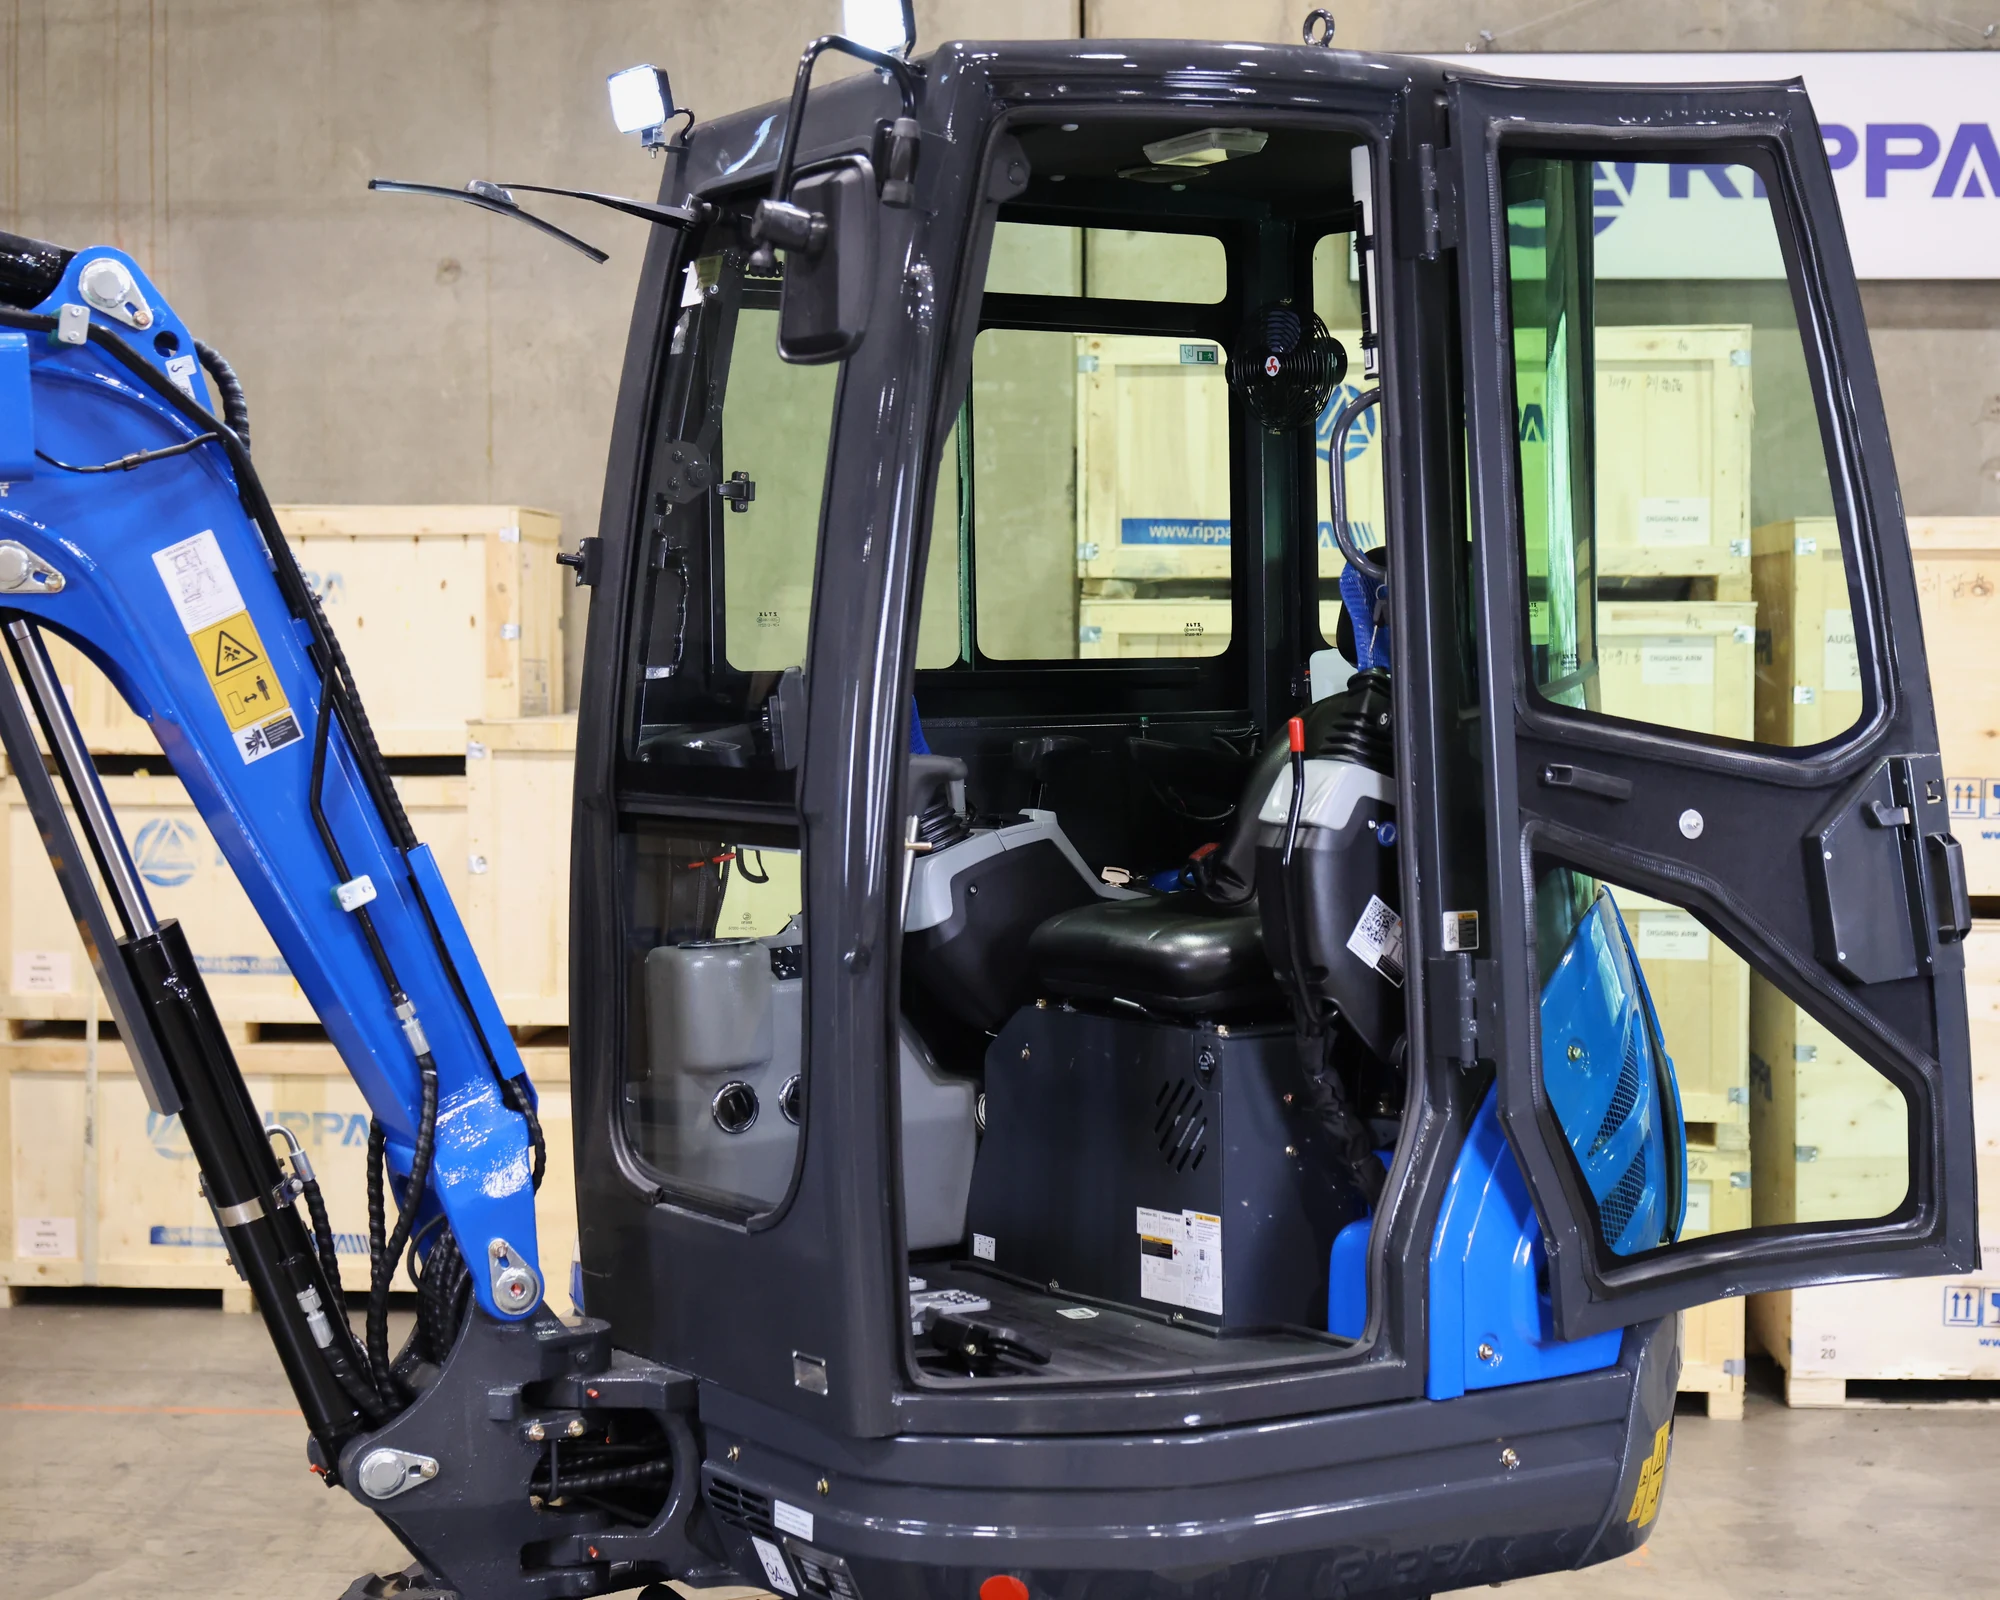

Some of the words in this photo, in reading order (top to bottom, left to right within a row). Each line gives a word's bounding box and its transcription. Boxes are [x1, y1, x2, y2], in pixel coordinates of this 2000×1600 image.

[1827, 634, 1857, 644] AUG
[264, 1112, 369, 1146] IPPA
[1821, 1349, 1836, 1359] 20
